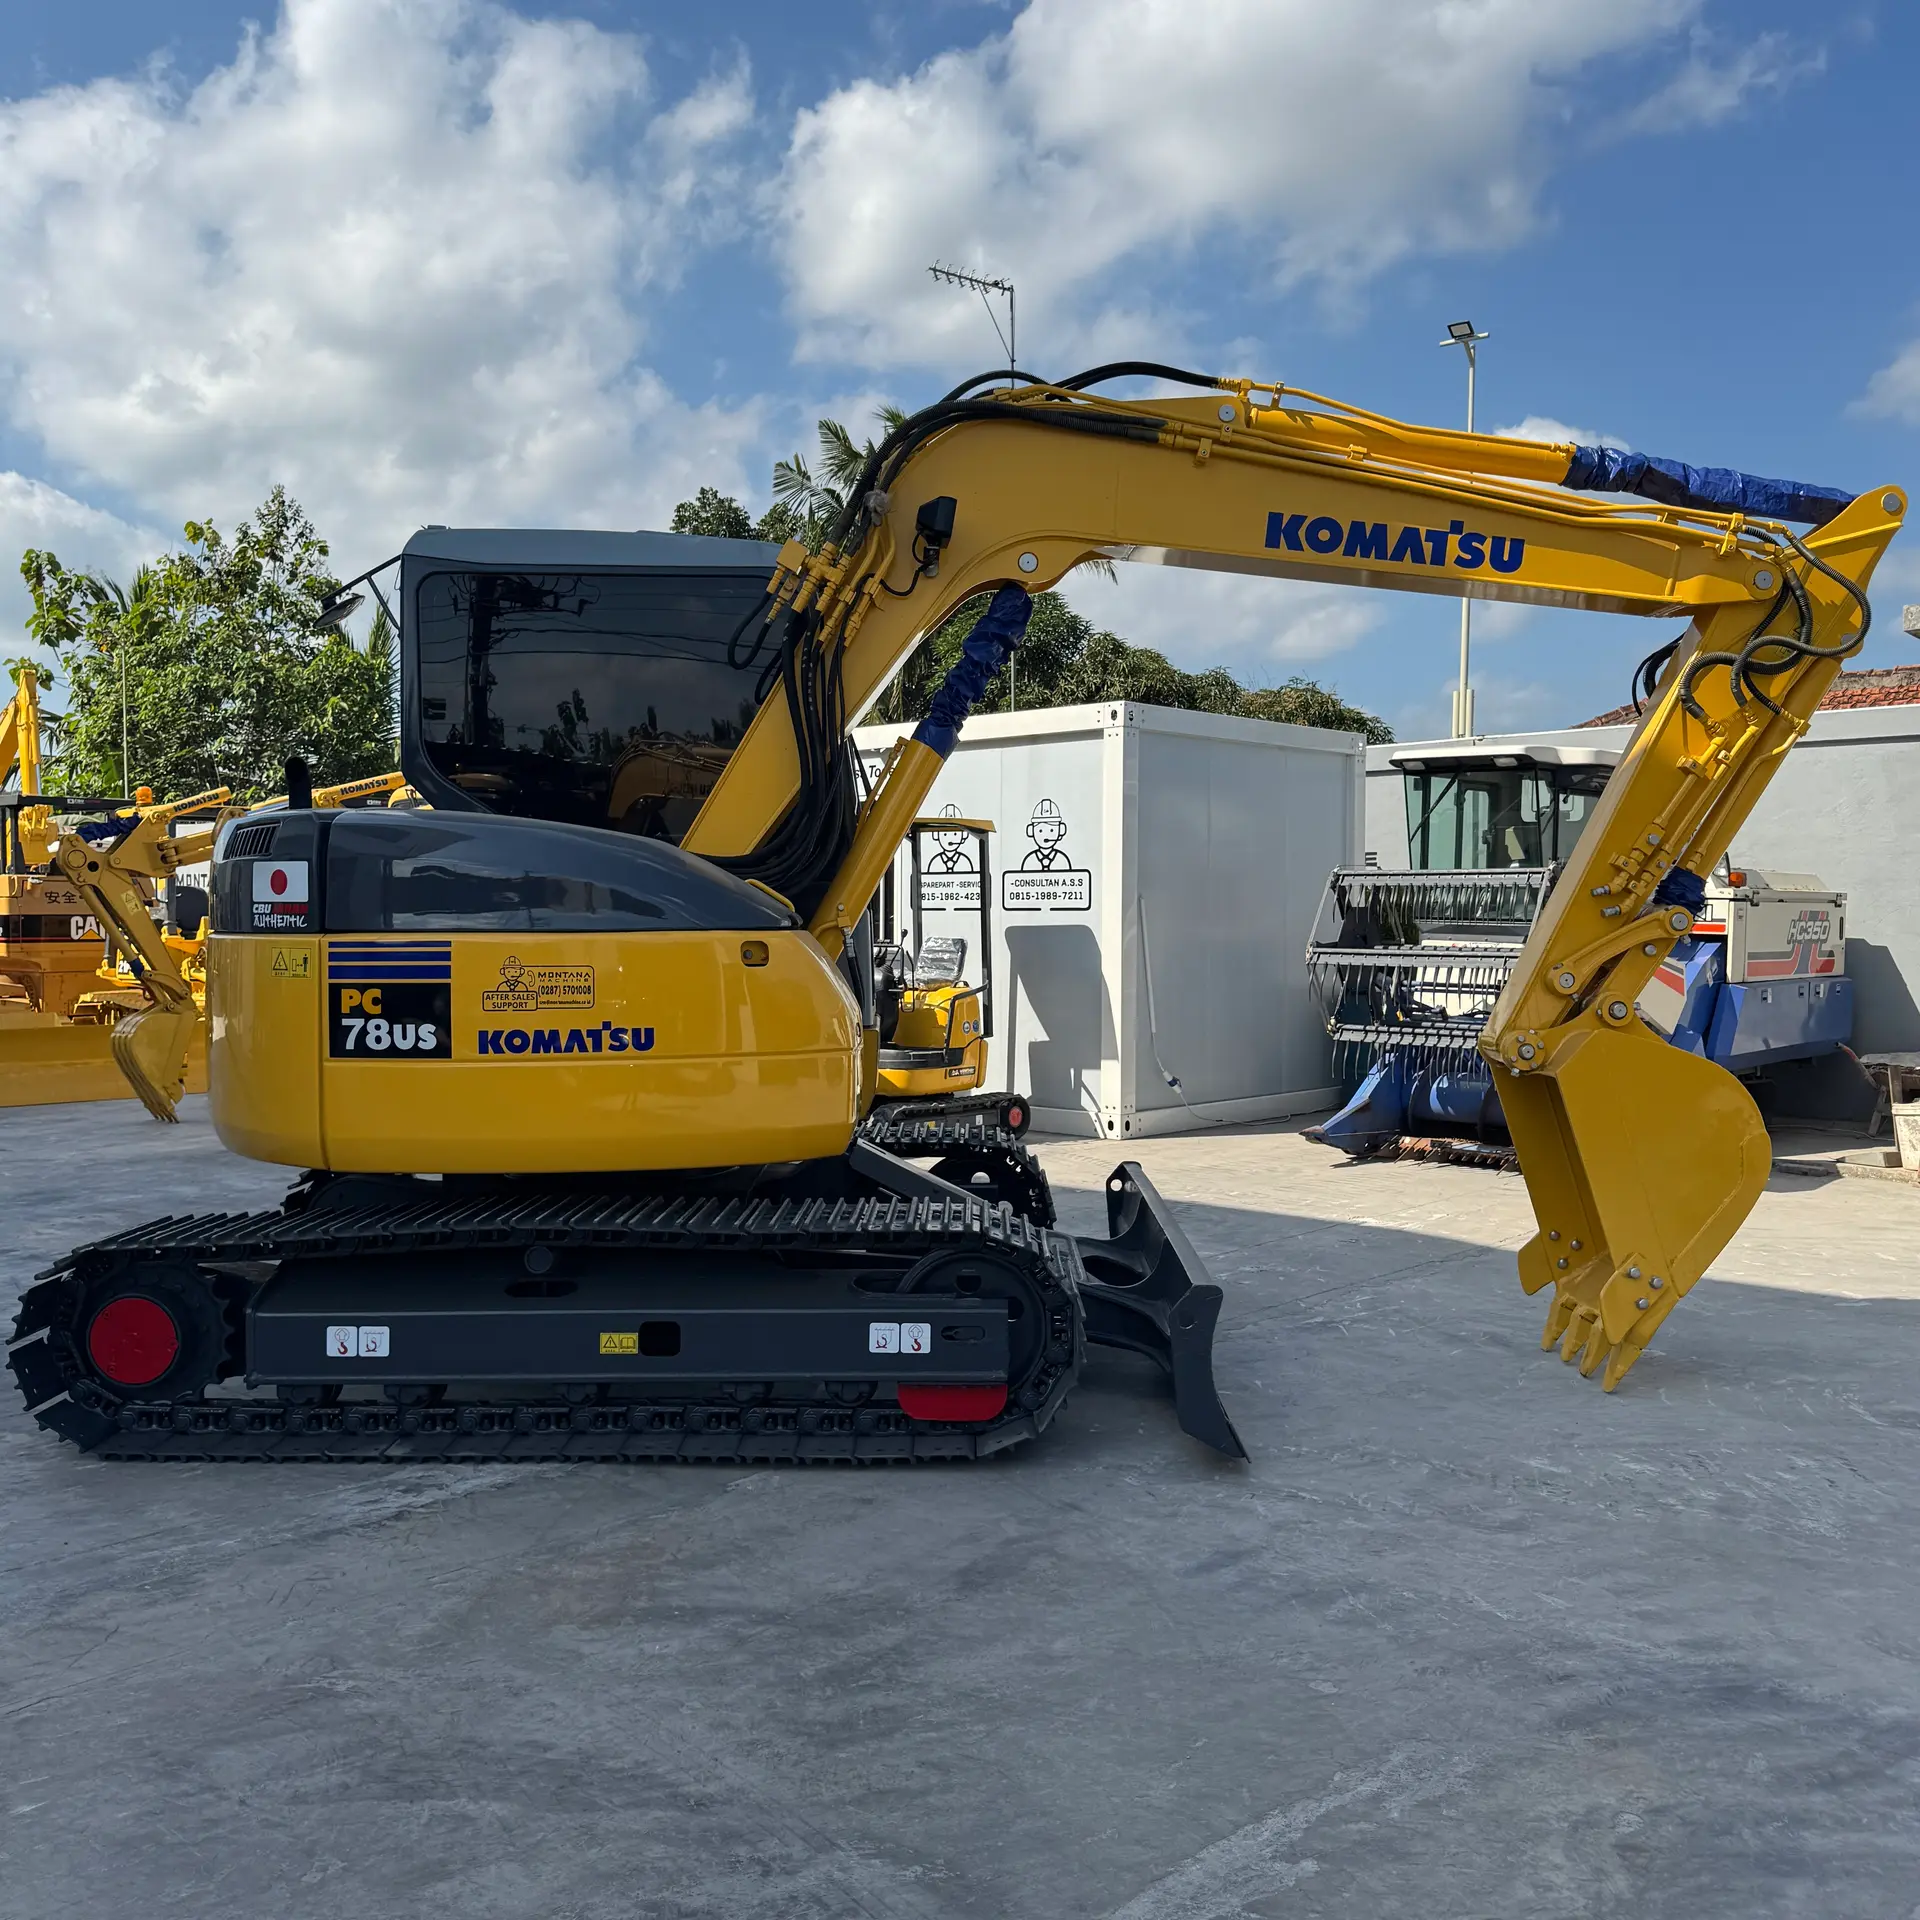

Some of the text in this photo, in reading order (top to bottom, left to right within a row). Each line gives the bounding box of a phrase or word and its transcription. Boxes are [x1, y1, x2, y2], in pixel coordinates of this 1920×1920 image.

[1264, 511, 1525, 573] KOMATSU
[340, 778, 388, 795] KOMATSU
[173, 792, 219, 812] KOMATSU
[176, 873, 210, 887] MONT
[956, 880, 981, 888] -SERVIC
[1010, 878, 1083, 887] -CONSULTAN A.S.S
[45, 889, 83, 905] 安全
[920, 892, 981, 901] 815-1962-423
[1009, 891, 1084, 900] 0815-1989-7211
[252, 903, 272, 914] CBU
[1787, 919, 1831, 945] HC350
[485, 993, 535, 1001] AFTER SALES
[538, 985, 592, 997] (0287) 5701008
[341, 988, 382, 1015] PC
[491, 1001, 529, 1009] SUPPORT
[341, 1018, 438, 1051] 78US
[478, 1020, 655, 1055] KOMATSU
